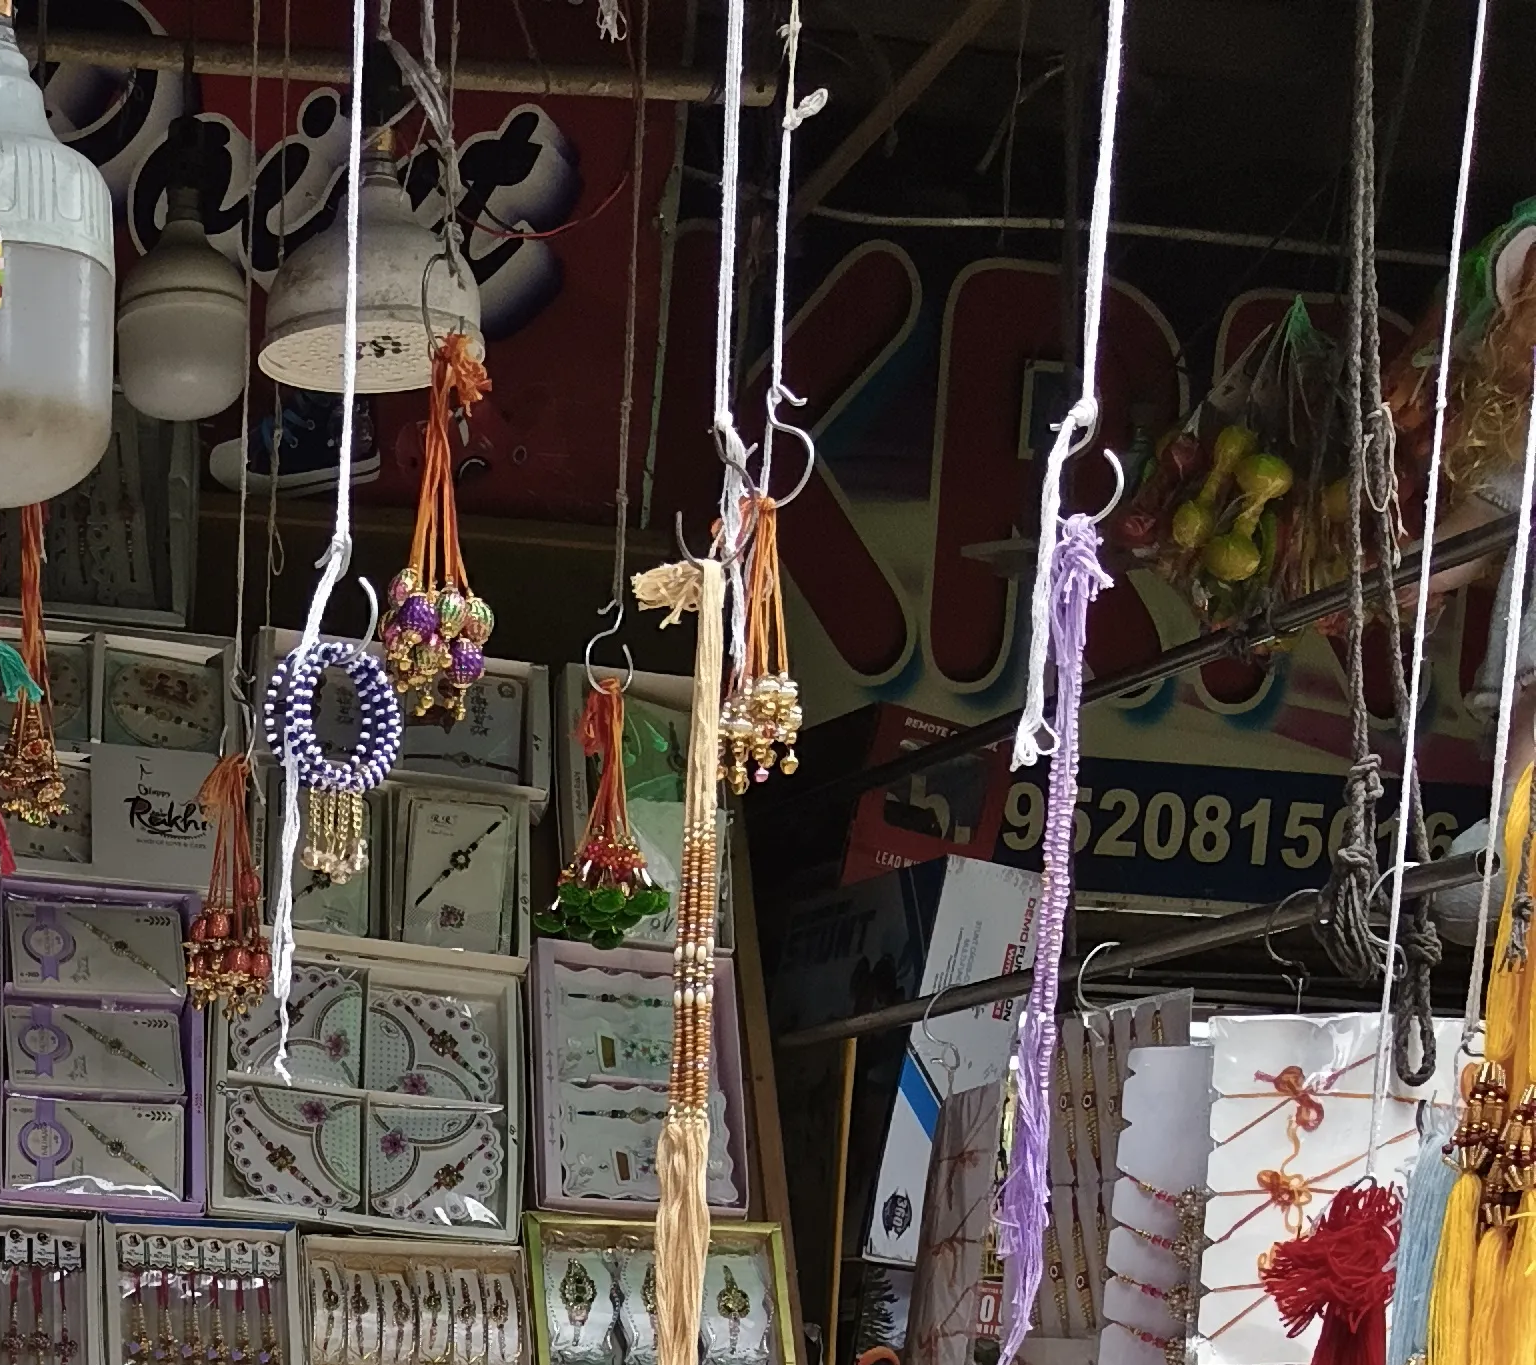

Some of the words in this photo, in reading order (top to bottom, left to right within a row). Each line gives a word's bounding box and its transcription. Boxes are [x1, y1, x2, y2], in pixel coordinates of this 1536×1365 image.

[904, 715, 949, 738] REMOTE
[123, 796, 219, 834] Rakhi
[875, 850, 901, 869] LEAD
[1019, 897, 1037, 943] DEMO
